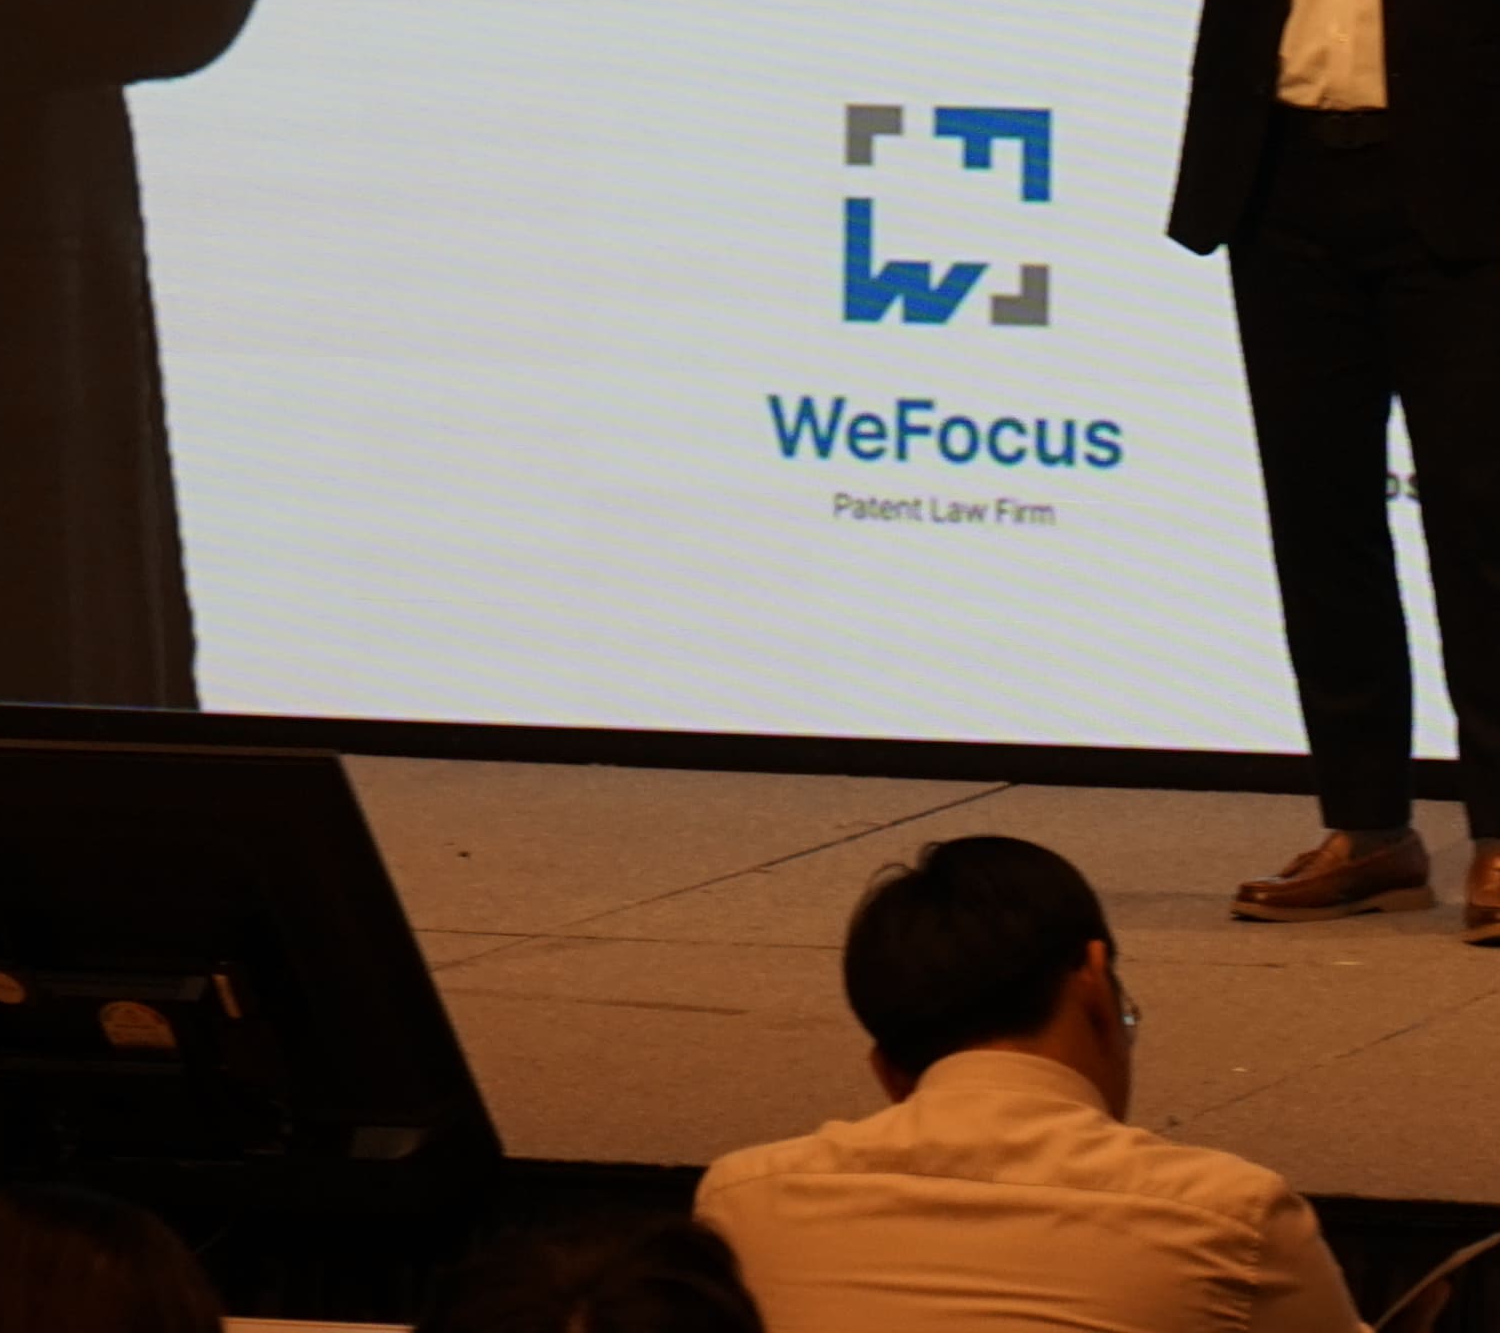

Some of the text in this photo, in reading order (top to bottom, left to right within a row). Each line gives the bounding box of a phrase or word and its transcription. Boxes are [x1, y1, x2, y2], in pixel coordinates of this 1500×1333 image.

[766, 393, 1125, 469] WeFocus
[832, 491, 1057, 527] Patent Law Firm
